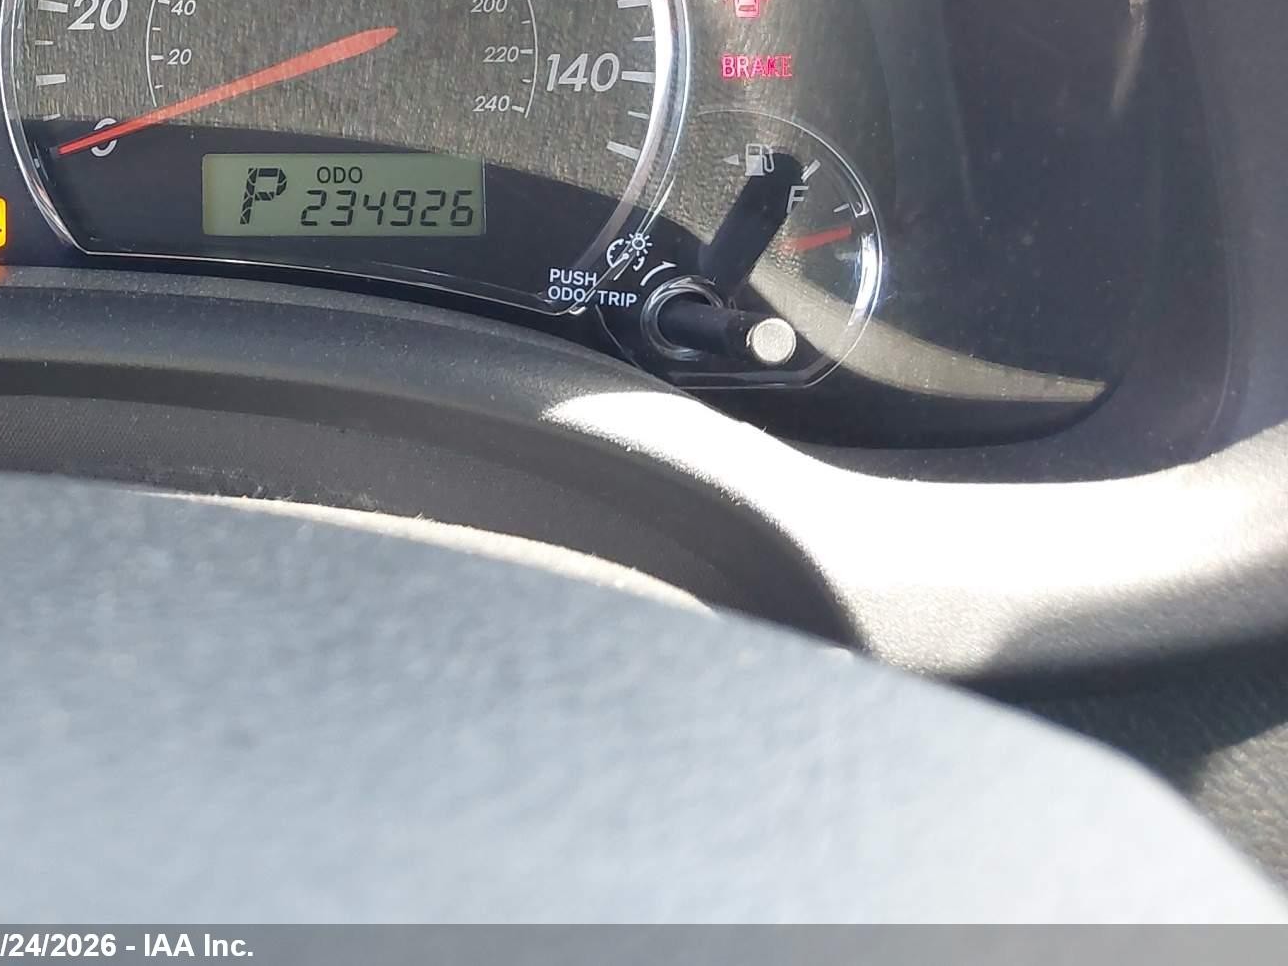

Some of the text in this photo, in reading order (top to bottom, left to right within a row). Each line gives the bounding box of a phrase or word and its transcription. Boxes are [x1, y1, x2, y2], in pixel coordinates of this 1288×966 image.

[171, 0, 196, 16] 40
[167, 48, 192, 65] 20
[483, 47, 519, 63] 220
[545, 53, 620, 92] 140
[721, 55, 793, 78] BRAKE
[473, 96, 510, 112] 240
[316, 166, 363, 184] ODO
[240, 168, 286, 224] P
[787, 186, 809, 211] F
[301, 189, 473, 227] 234926
[549, 268, 597, 286] PUSH
